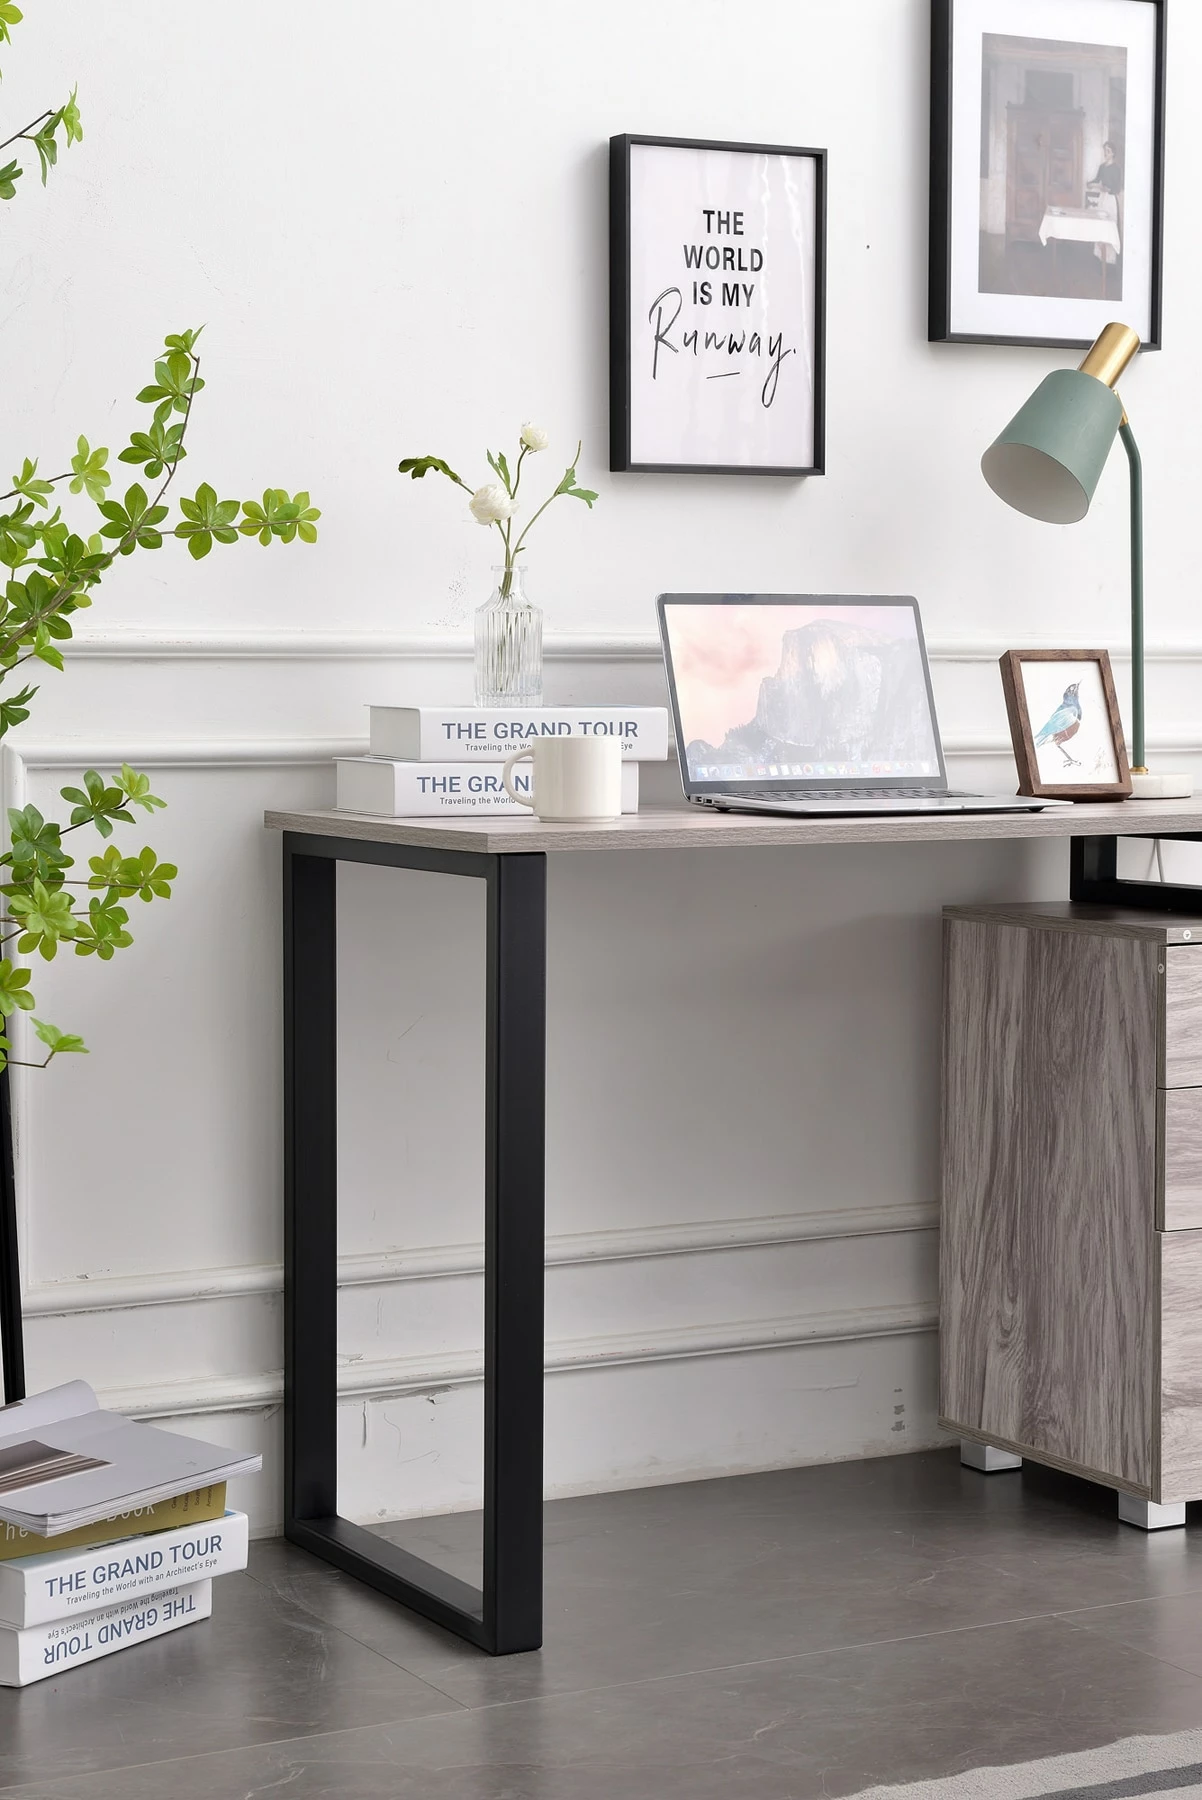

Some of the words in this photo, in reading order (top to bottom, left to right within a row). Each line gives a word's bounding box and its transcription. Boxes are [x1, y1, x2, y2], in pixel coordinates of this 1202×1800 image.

[702, 210, 744, 236] THE
[683, 244, 764, 272] WORLD
[692, 281, 712, 305] IS
[721, 282, 755, 308] MY
[648, 286, 796, 408] Runway.
[442, 723, 487, 739] THE
[493, 722, 572, 739] GRAND
[578, 721, 638, 738] TOUR
[465, 743, 502, 753] Traveling
[504, 743, 517, 751] the
[416, 776, 461, 793] THE
[467, 775, 534, 792] GRN
[440, 797, 477, 806] Traveling
[479, 796, 491, 805] the
[45, 1570, 87, 1597] THE
[93, 1551, 163, 1585] GRAND
[169, 1535, 222, 1563] TOUR
[66, 1590, 100, 1605] Traveling
[102, 1586, 114, 1596] the
[115, 1578, 137, 1591] World
[138, 1574, 154, 1586] with
[155, 1572, 164, 1581] an
[165, 1561, 203, 1578] Architect's
[205, 1558, 218, 1569] Eye
[120, 1602, 138, 1614] World
[140, 1597, 149, 1606] the
[163, 1594, 196, 1622] THE
[97, 1613, 104, 1622] an
[105, 1609, 119, 1620] with
[48, 1629, 60, 1639] Eye
[98, 1608, 158, 1644] GRAND
[44, 1632, 93, 1665] TOUR
